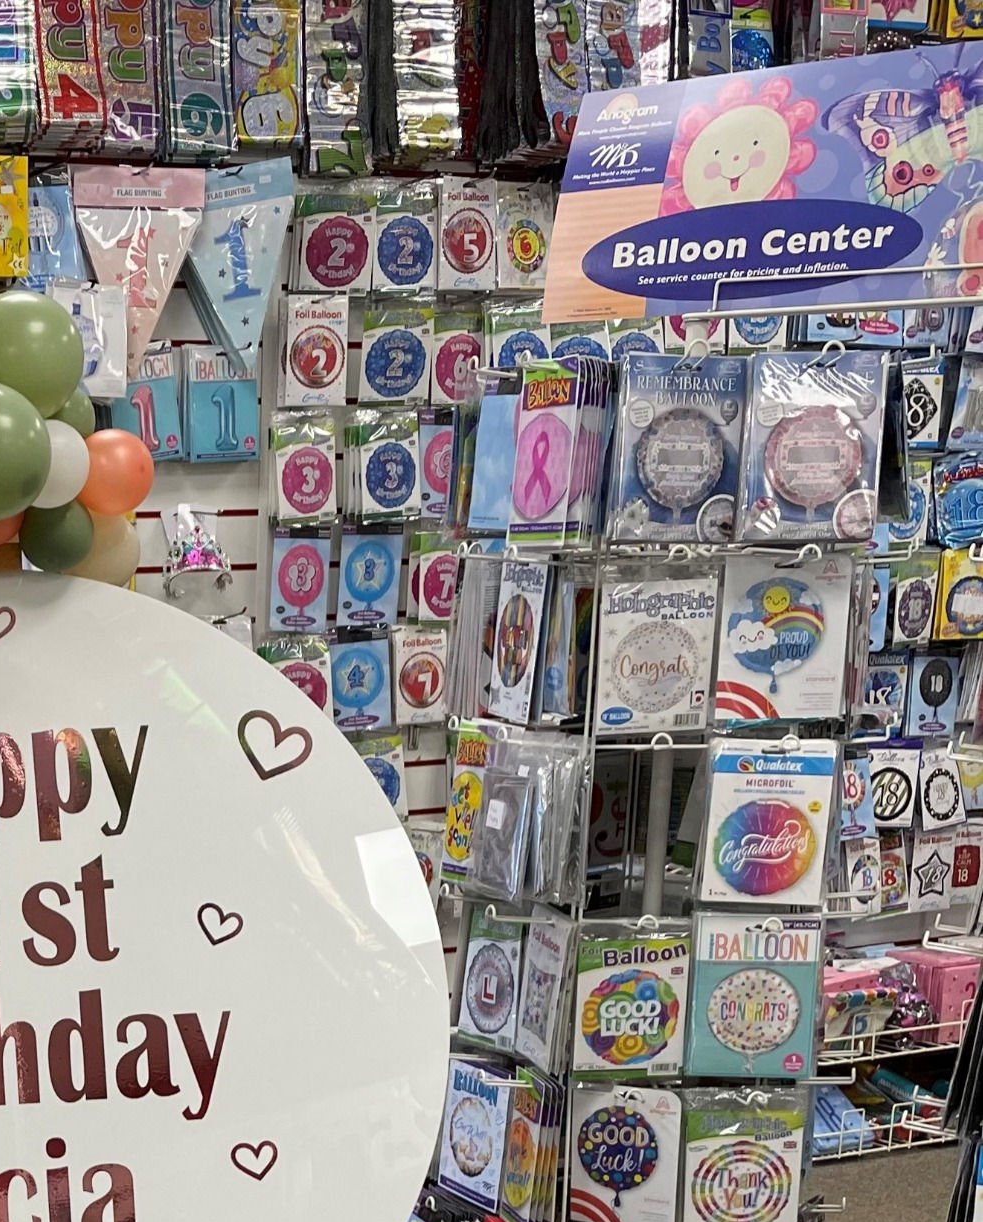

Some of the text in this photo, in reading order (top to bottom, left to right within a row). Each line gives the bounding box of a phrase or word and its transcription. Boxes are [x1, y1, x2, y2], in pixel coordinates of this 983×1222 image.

[612, 222, 895, 269] Balloon Center
[637, 261, 850, 286] See service counter for pricing and inflation.
[295, 308, 342, 320] Foil Balloon
[636, 374, 737, 392] REMEMBRANCE
[660, 611, 714, 621] BALLOON
[779, 630, 810, 645] PROUD
[768, 642, 811, 659] OF YOU!
[619, 653, 691, 686] Congrats
[755, 758, 804, 773] Qualatex
[718, 819, 812, 873] Congratulations
[603, 942, 688, 967] Balloon
[714, 932, 809, 961] BALLOON
[599, 999, 662, 1019] GOOD
[720, 1000, 790, 1022] CONGRATS!
[600, 1017, 660, 1037] LUCK!
[587, 1121, 650, 1147] GOOD
[754, 1129, 793, 1142] Balloon
[591, 1146, 645, 1172] Luck!
[717, 1167, 769, 1190] Thank
[723, 1186, 761, 1211] You!
